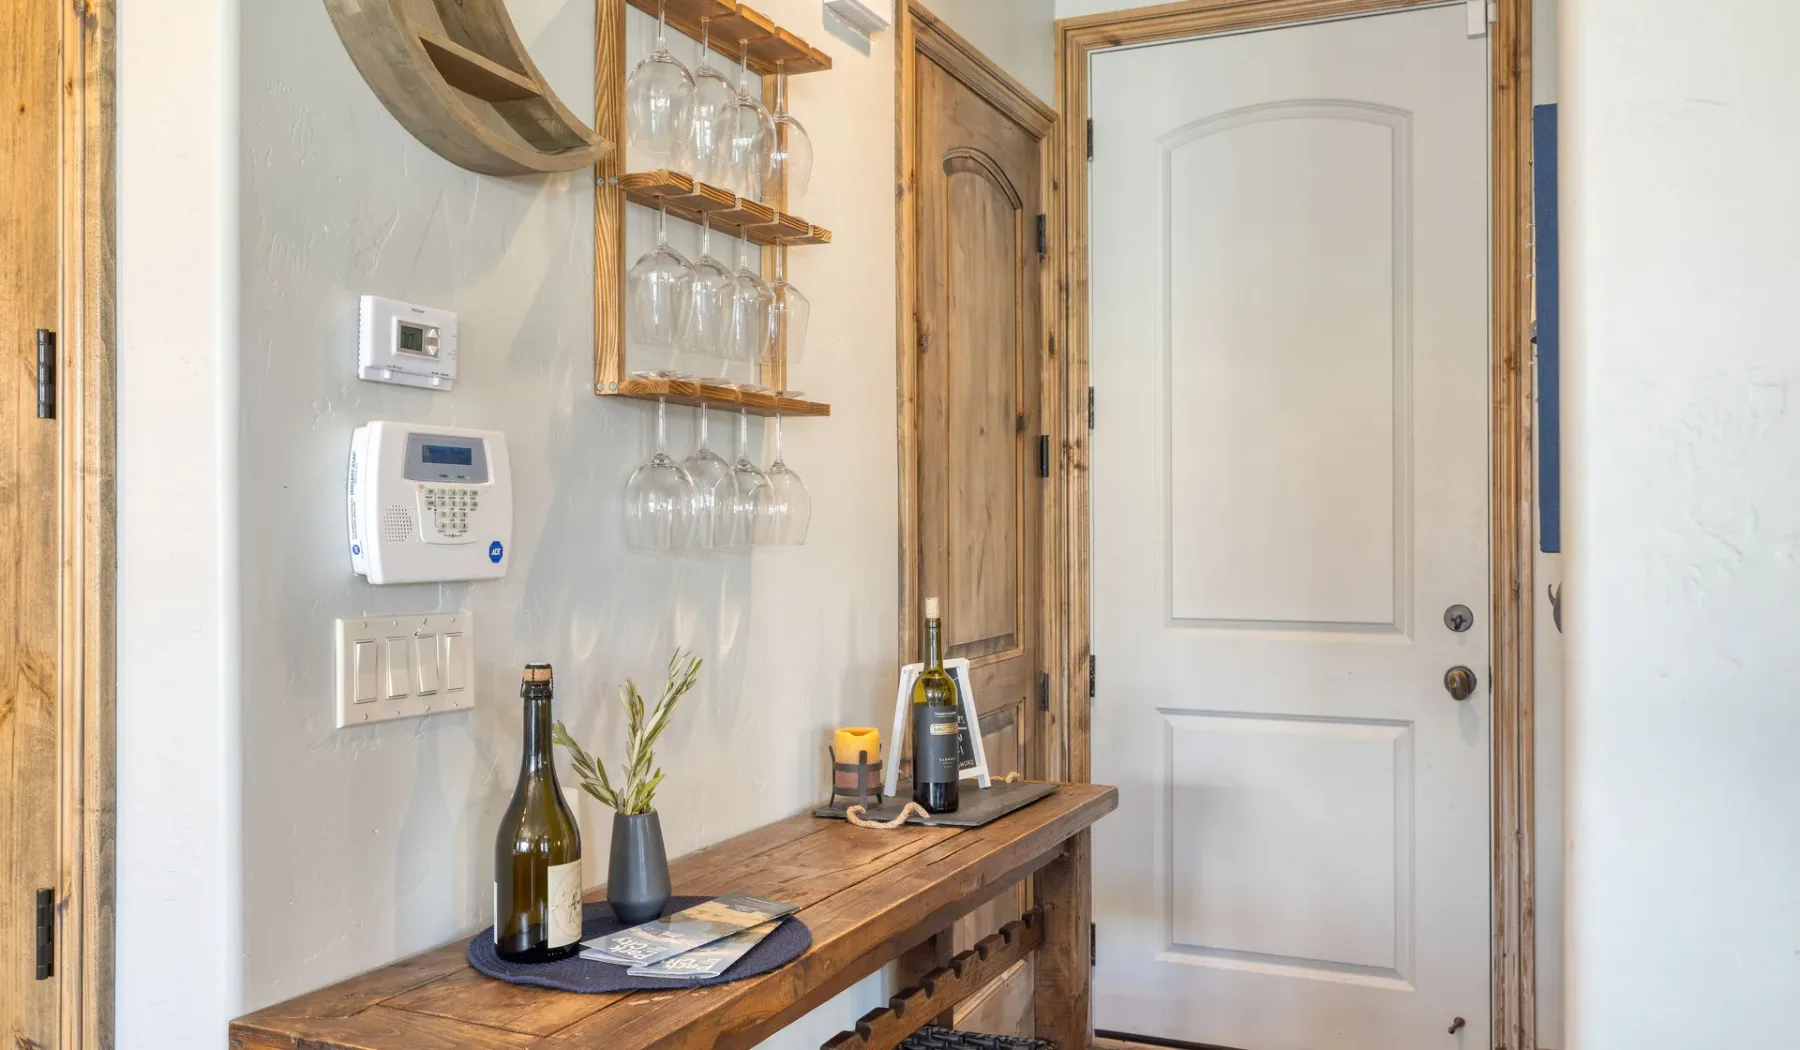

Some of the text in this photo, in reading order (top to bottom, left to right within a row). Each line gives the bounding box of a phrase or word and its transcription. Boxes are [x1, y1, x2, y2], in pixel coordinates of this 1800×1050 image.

[491, 548, 502, 556] ADT
[611, 937, 648, 950] City
[608, 945, 653, 960] Park
